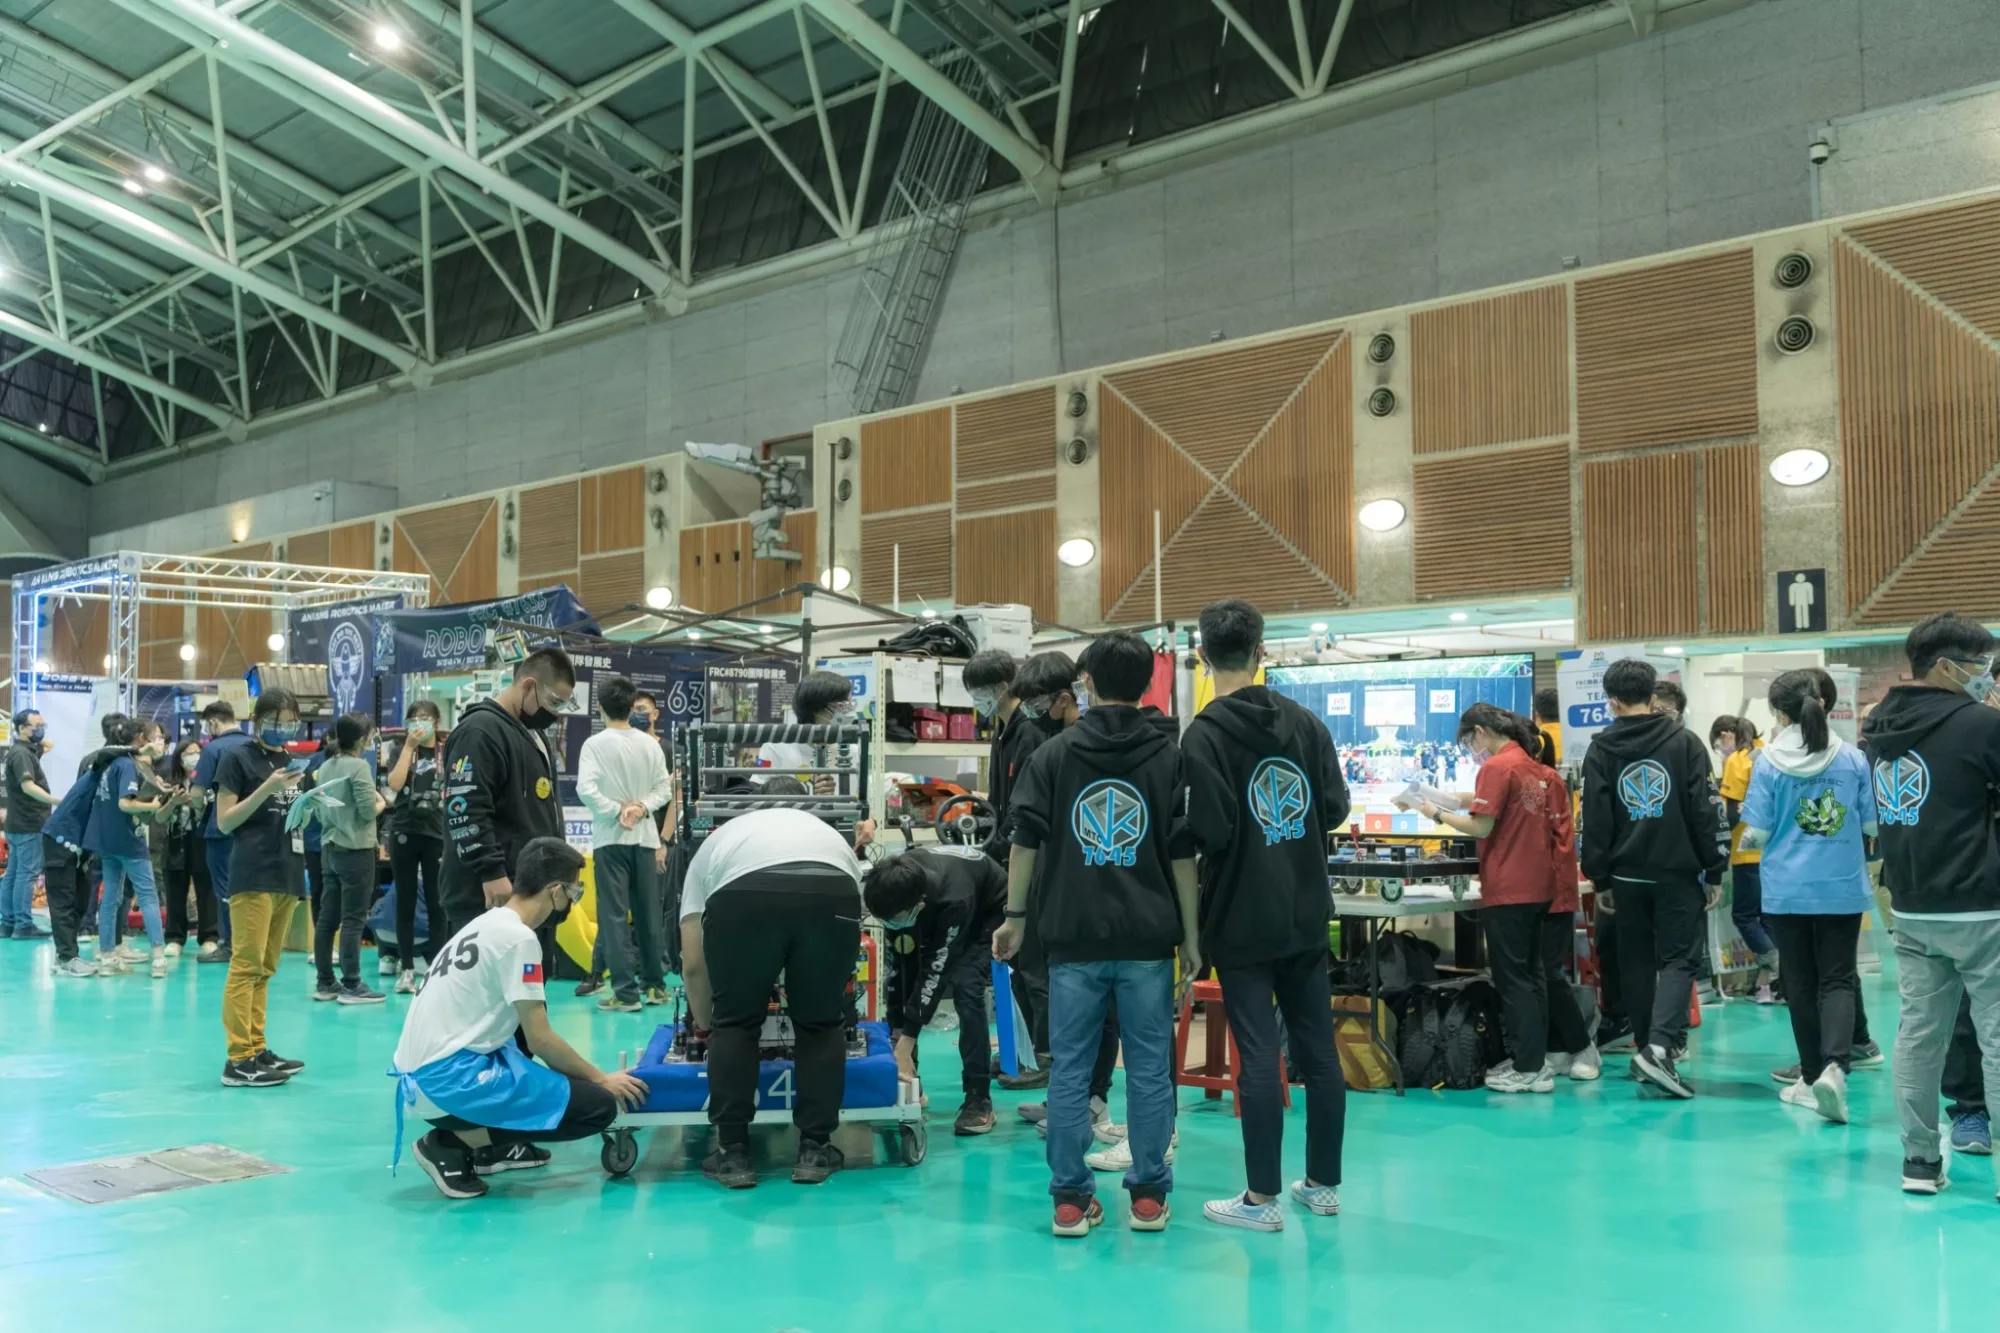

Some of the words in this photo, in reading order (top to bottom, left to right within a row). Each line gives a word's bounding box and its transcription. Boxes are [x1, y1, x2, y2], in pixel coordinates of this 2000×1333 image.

[1374, 819, 1382, 829] 0
[1878, 806, 1919, 825] 7645
[1263, 819, 1306, 846] 7645
[1082, 845, 1136, 866] 7645
